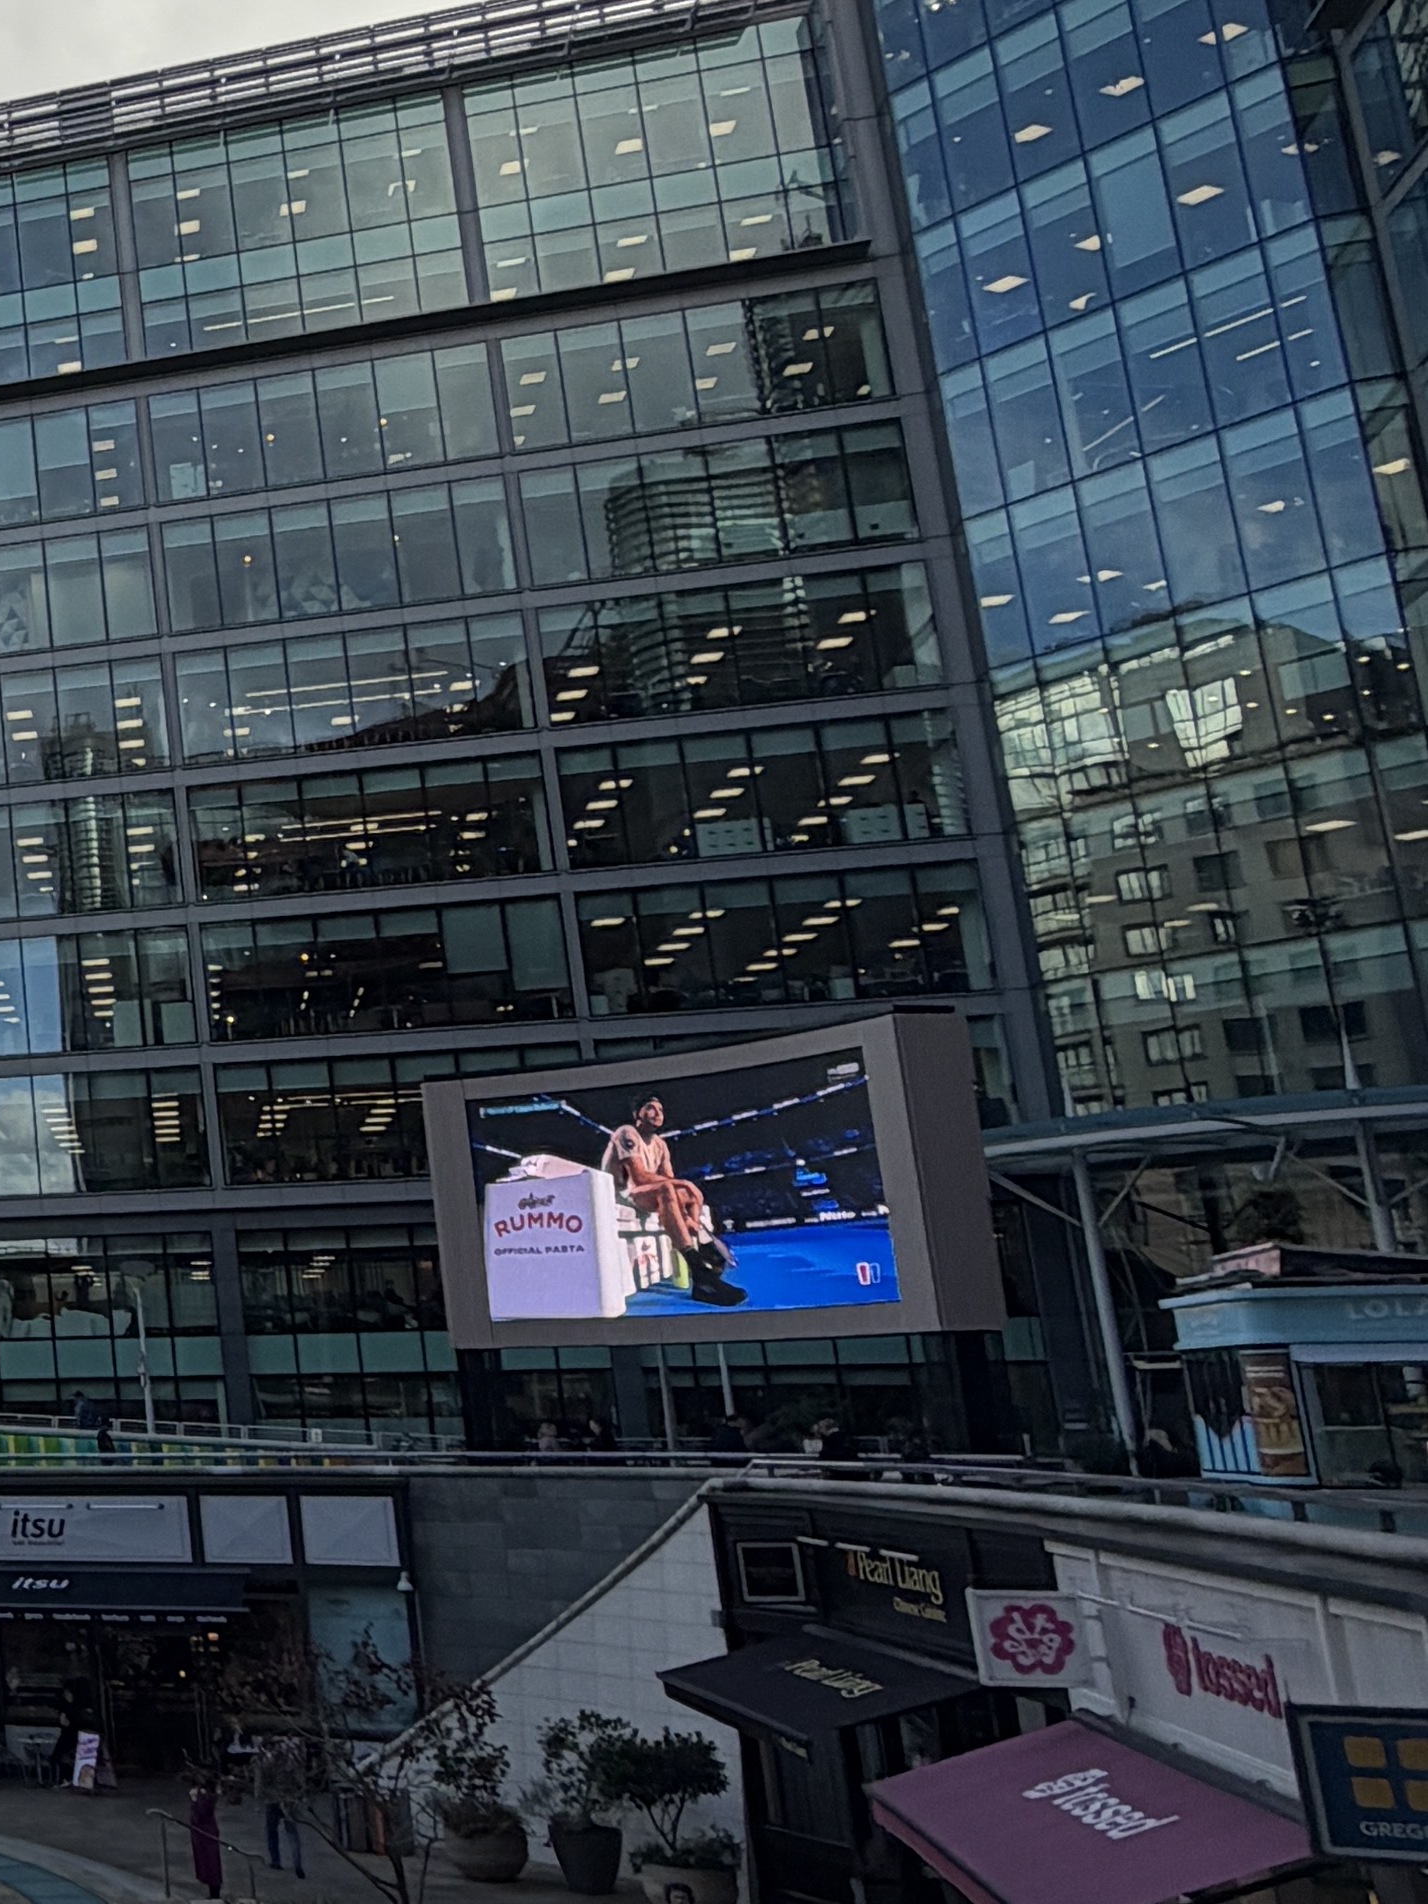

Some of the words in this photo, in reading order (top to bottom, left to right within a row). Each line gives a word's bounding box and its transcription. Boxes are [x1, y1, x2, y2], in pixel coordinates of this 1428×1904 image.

[494, 1211, 583, 1238] RUMMO
[494, 1247, 542, 1256] OFFICIAL
[545, 1244, 585, 1254] PASTA
[11, 1510, 65, 1538] itsu
[11, 1576, 70, 1590] itsu
[857, 1551, 895, 1586] Pearl
[895, 1556, 943, 1605] Liang
[1190, 1636, 1282, 1719] tossed
[1052, 1783, 1180, 1840] tossed
[1359, 1821, 1428, 1840] GREG
